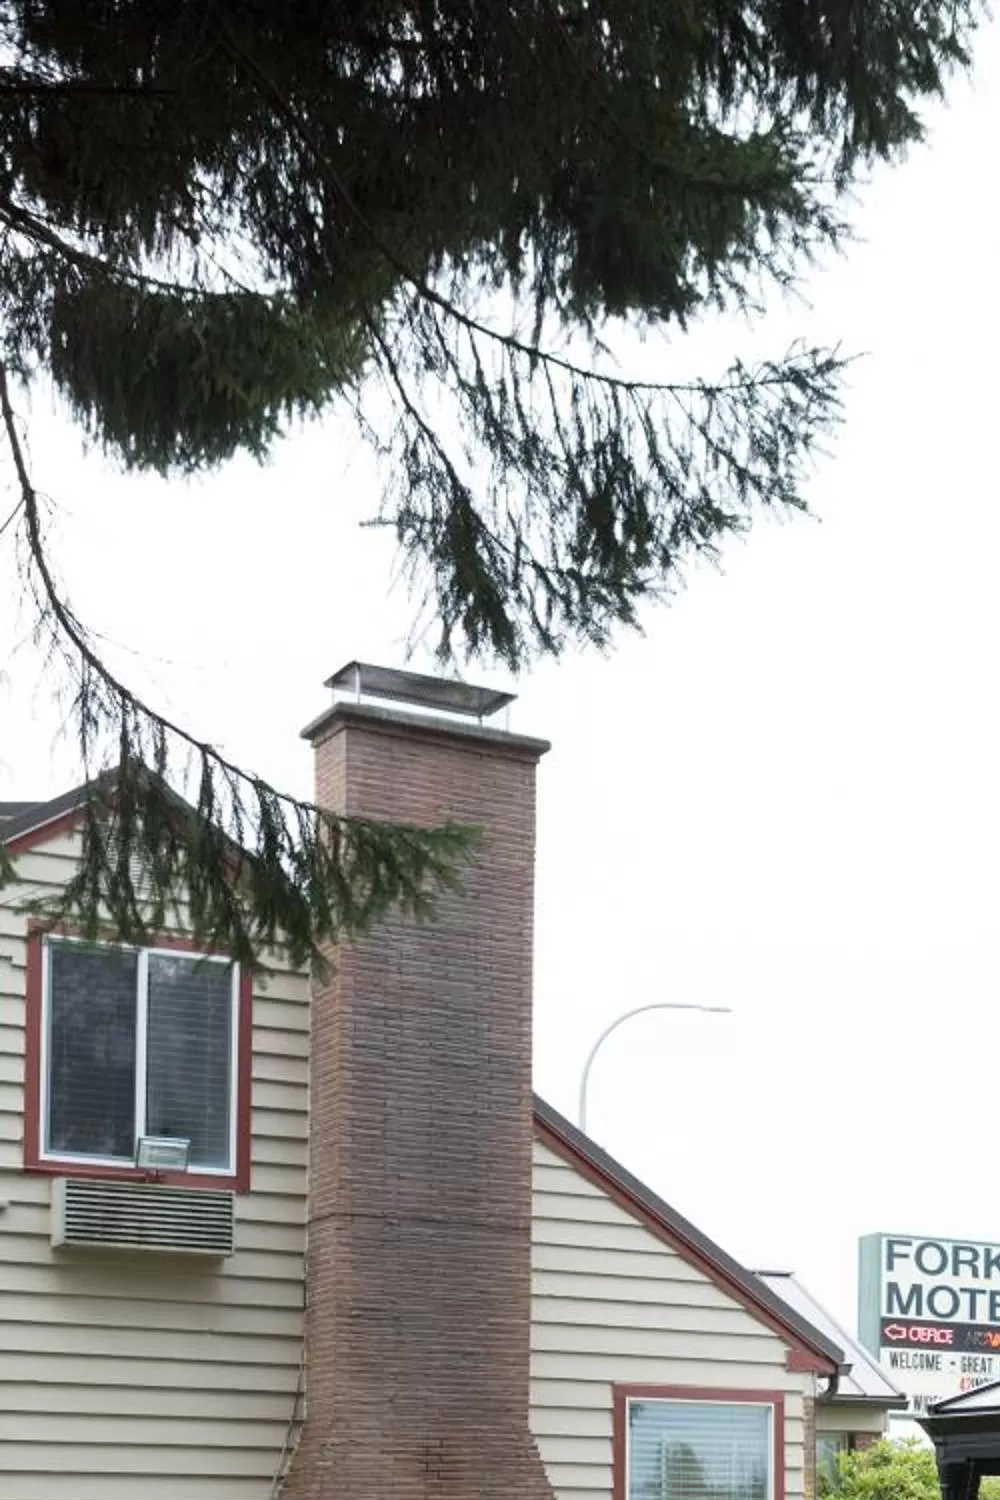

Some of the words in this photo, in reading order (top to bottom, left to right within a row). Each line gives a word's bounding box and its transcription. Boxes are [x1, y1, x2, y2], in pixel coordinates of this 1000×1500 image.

[908, 1327, 953, 1344] OFFICE
[889, 1351, 941, 1371] WELCOME
[961, 1354, 993, 1374] GREAT
